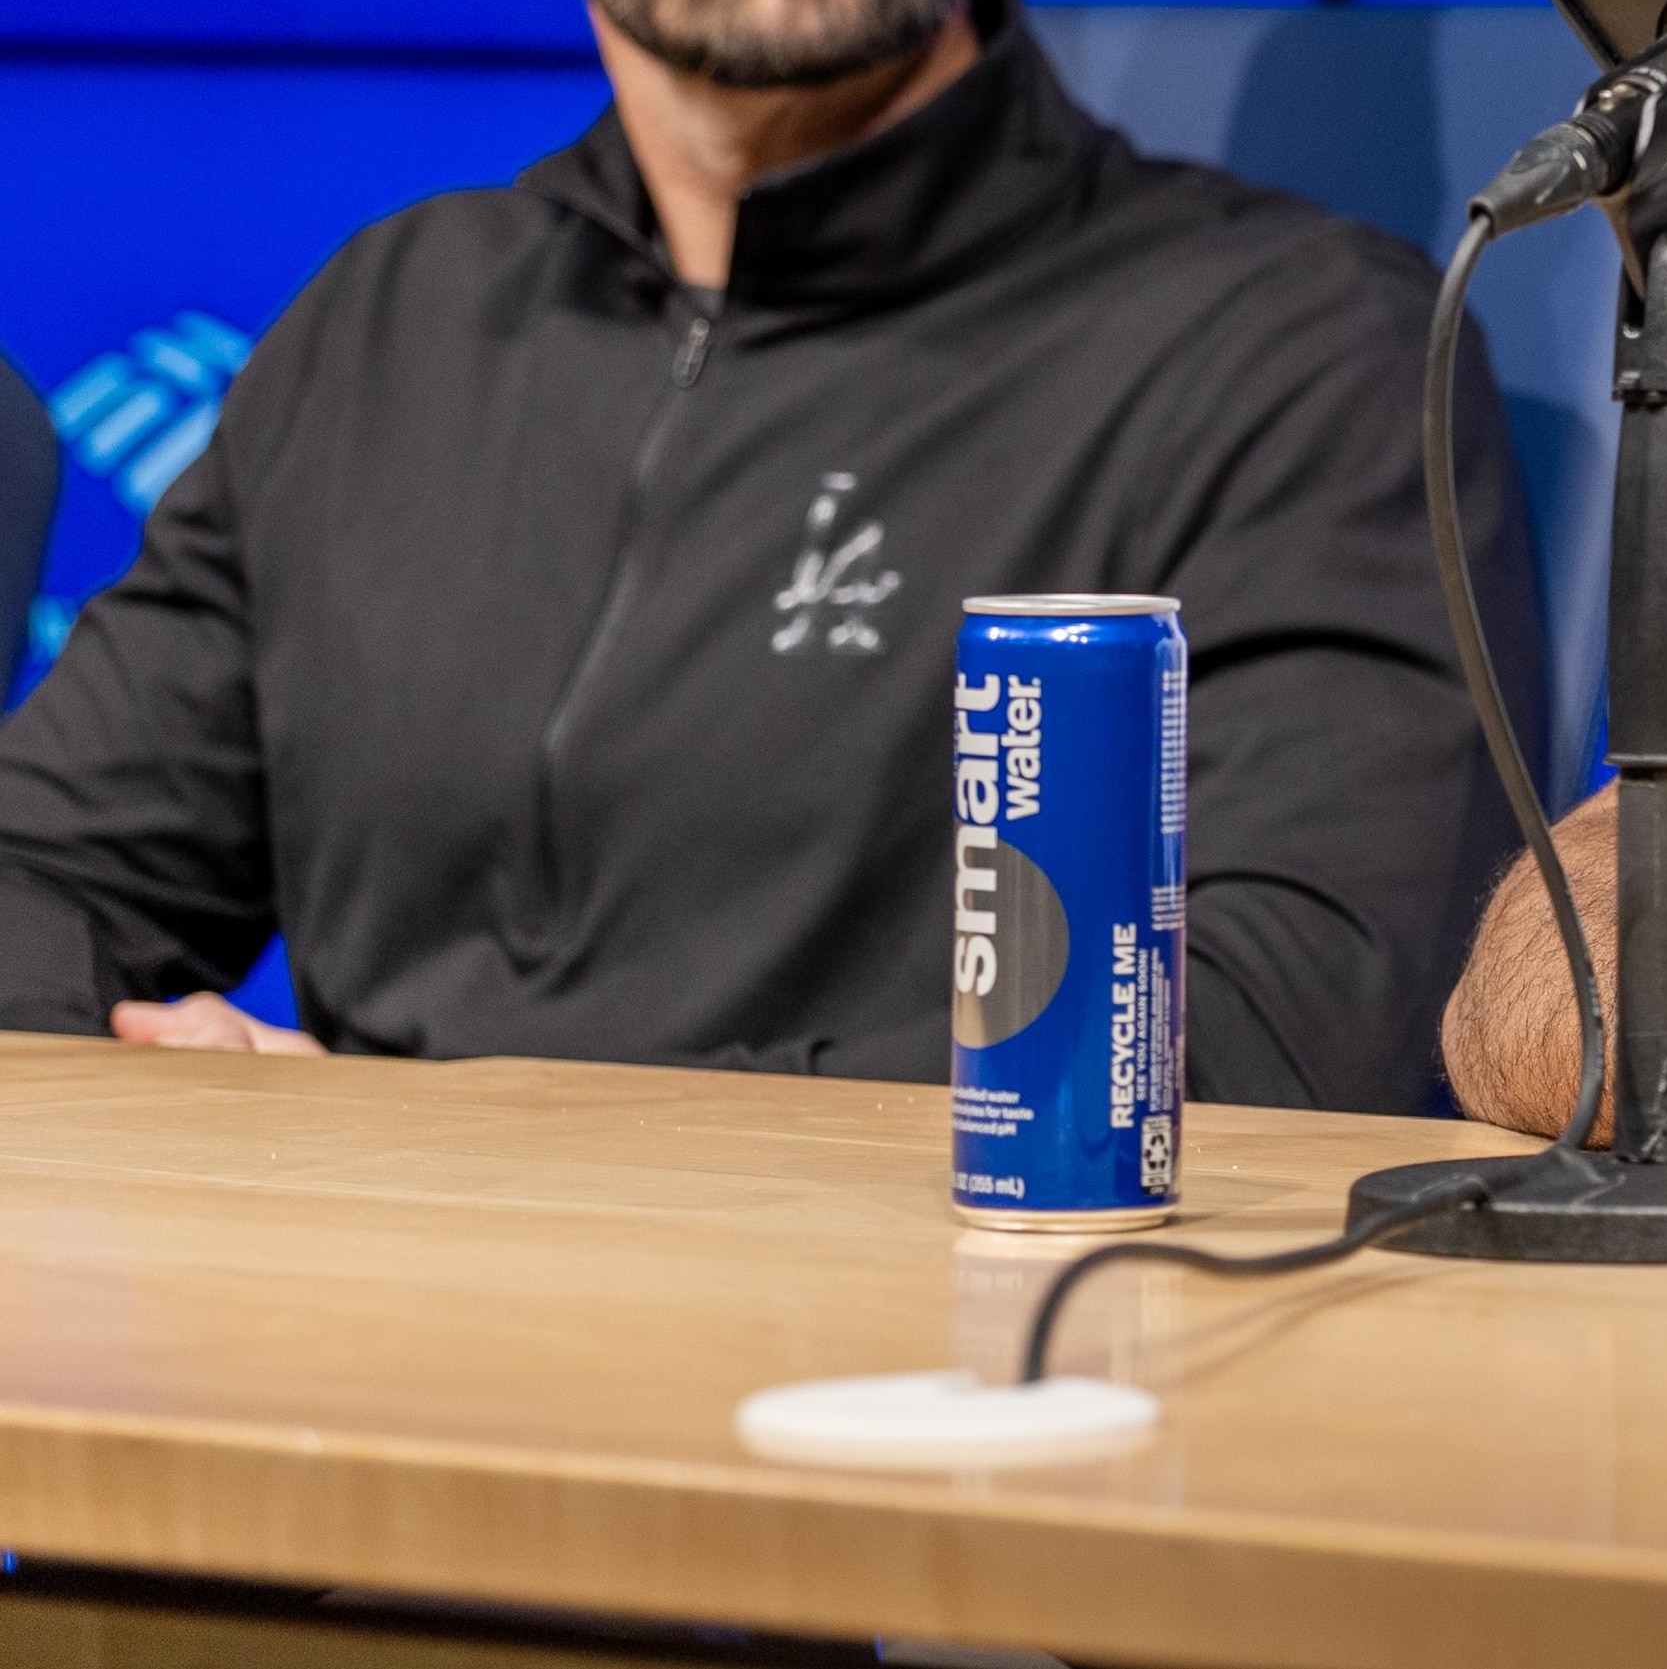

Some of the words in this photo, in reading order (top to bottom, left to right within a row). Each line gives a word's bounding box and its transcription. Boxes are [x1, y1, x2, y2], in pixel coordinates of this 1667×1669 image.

[953, 673, 1001, 996] smart
[1112, 922, 1137, 975] ME
[1136, 996, 1149, 1039] AGAIN
[1110, 983, 1137, 1128] RECYCLE
[1136, 1043, 1148, 1072] YOU
[1136, 1075, 1148, 1101] SEE
